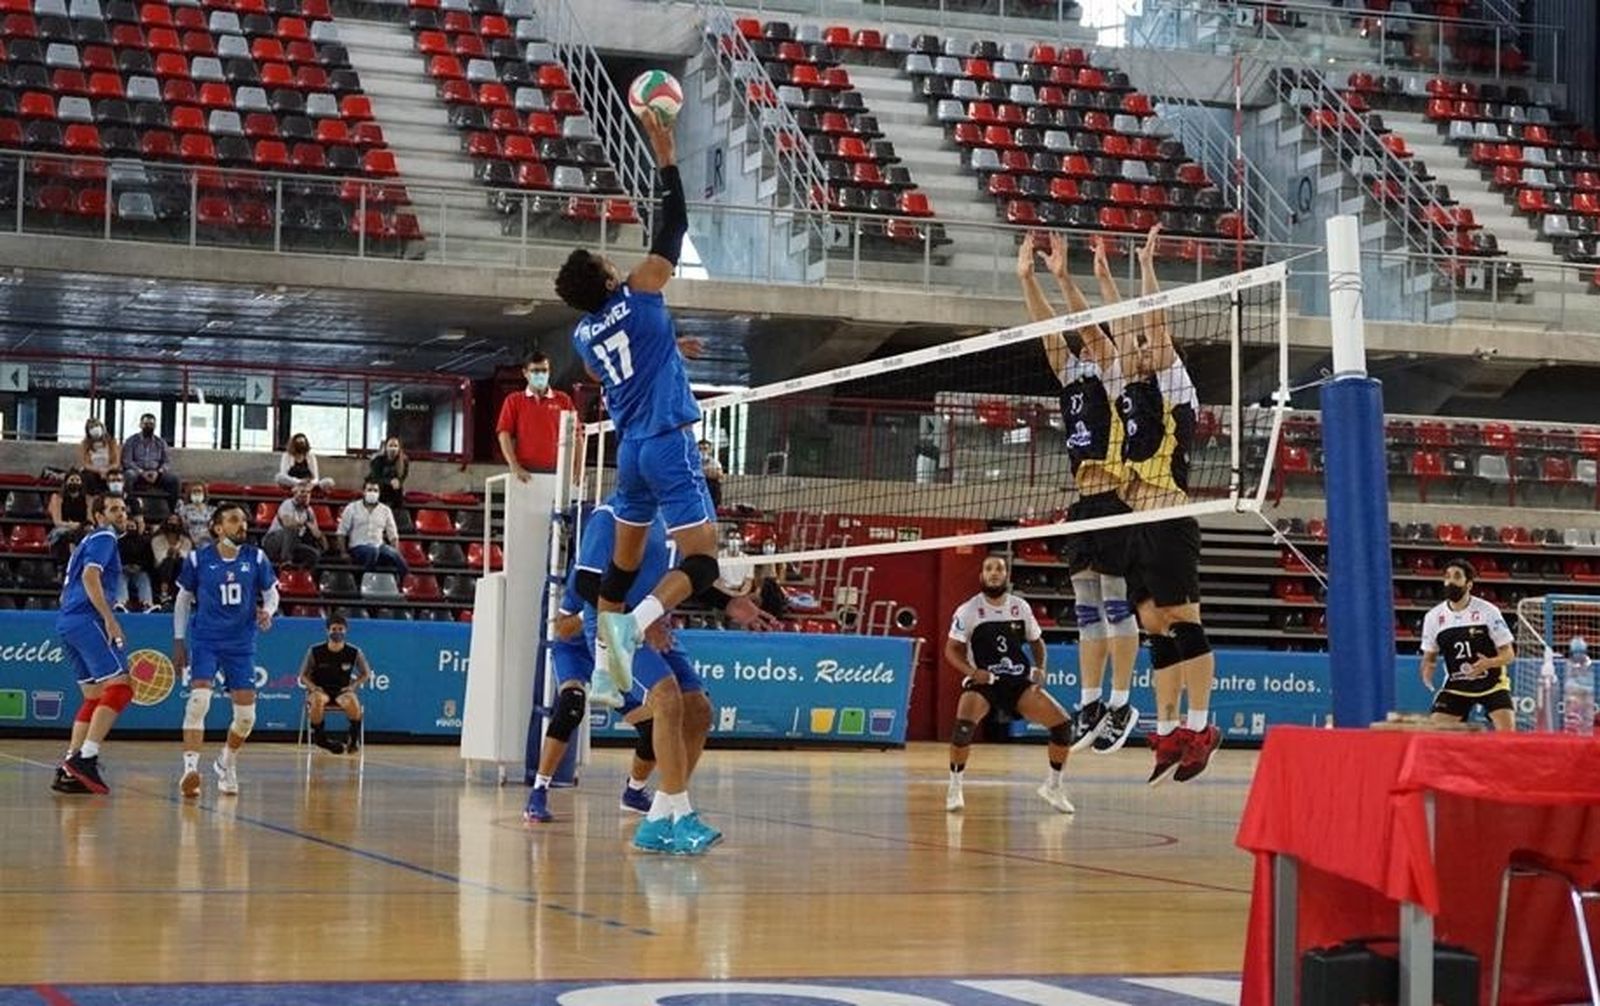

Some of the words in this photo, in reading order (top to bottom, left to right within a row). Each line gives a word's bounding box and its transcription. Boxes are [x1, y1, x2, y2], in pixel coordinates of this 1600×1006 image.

[592, 329, 634, 385] 17
[219, 583, 242, 605] 10
[0, 640, 65, 662] cicla
[996, 635, 1008, 652] 3
[1454, 641, 1472, 659] 21
[694, 660, 724, 679] tre
[734, 658, 804, 681] todos.
[814, 660, 895, 684] Recicla
[1047, 670, 1077, 686] nto
[1264, 672, 1321, 692] todos.
